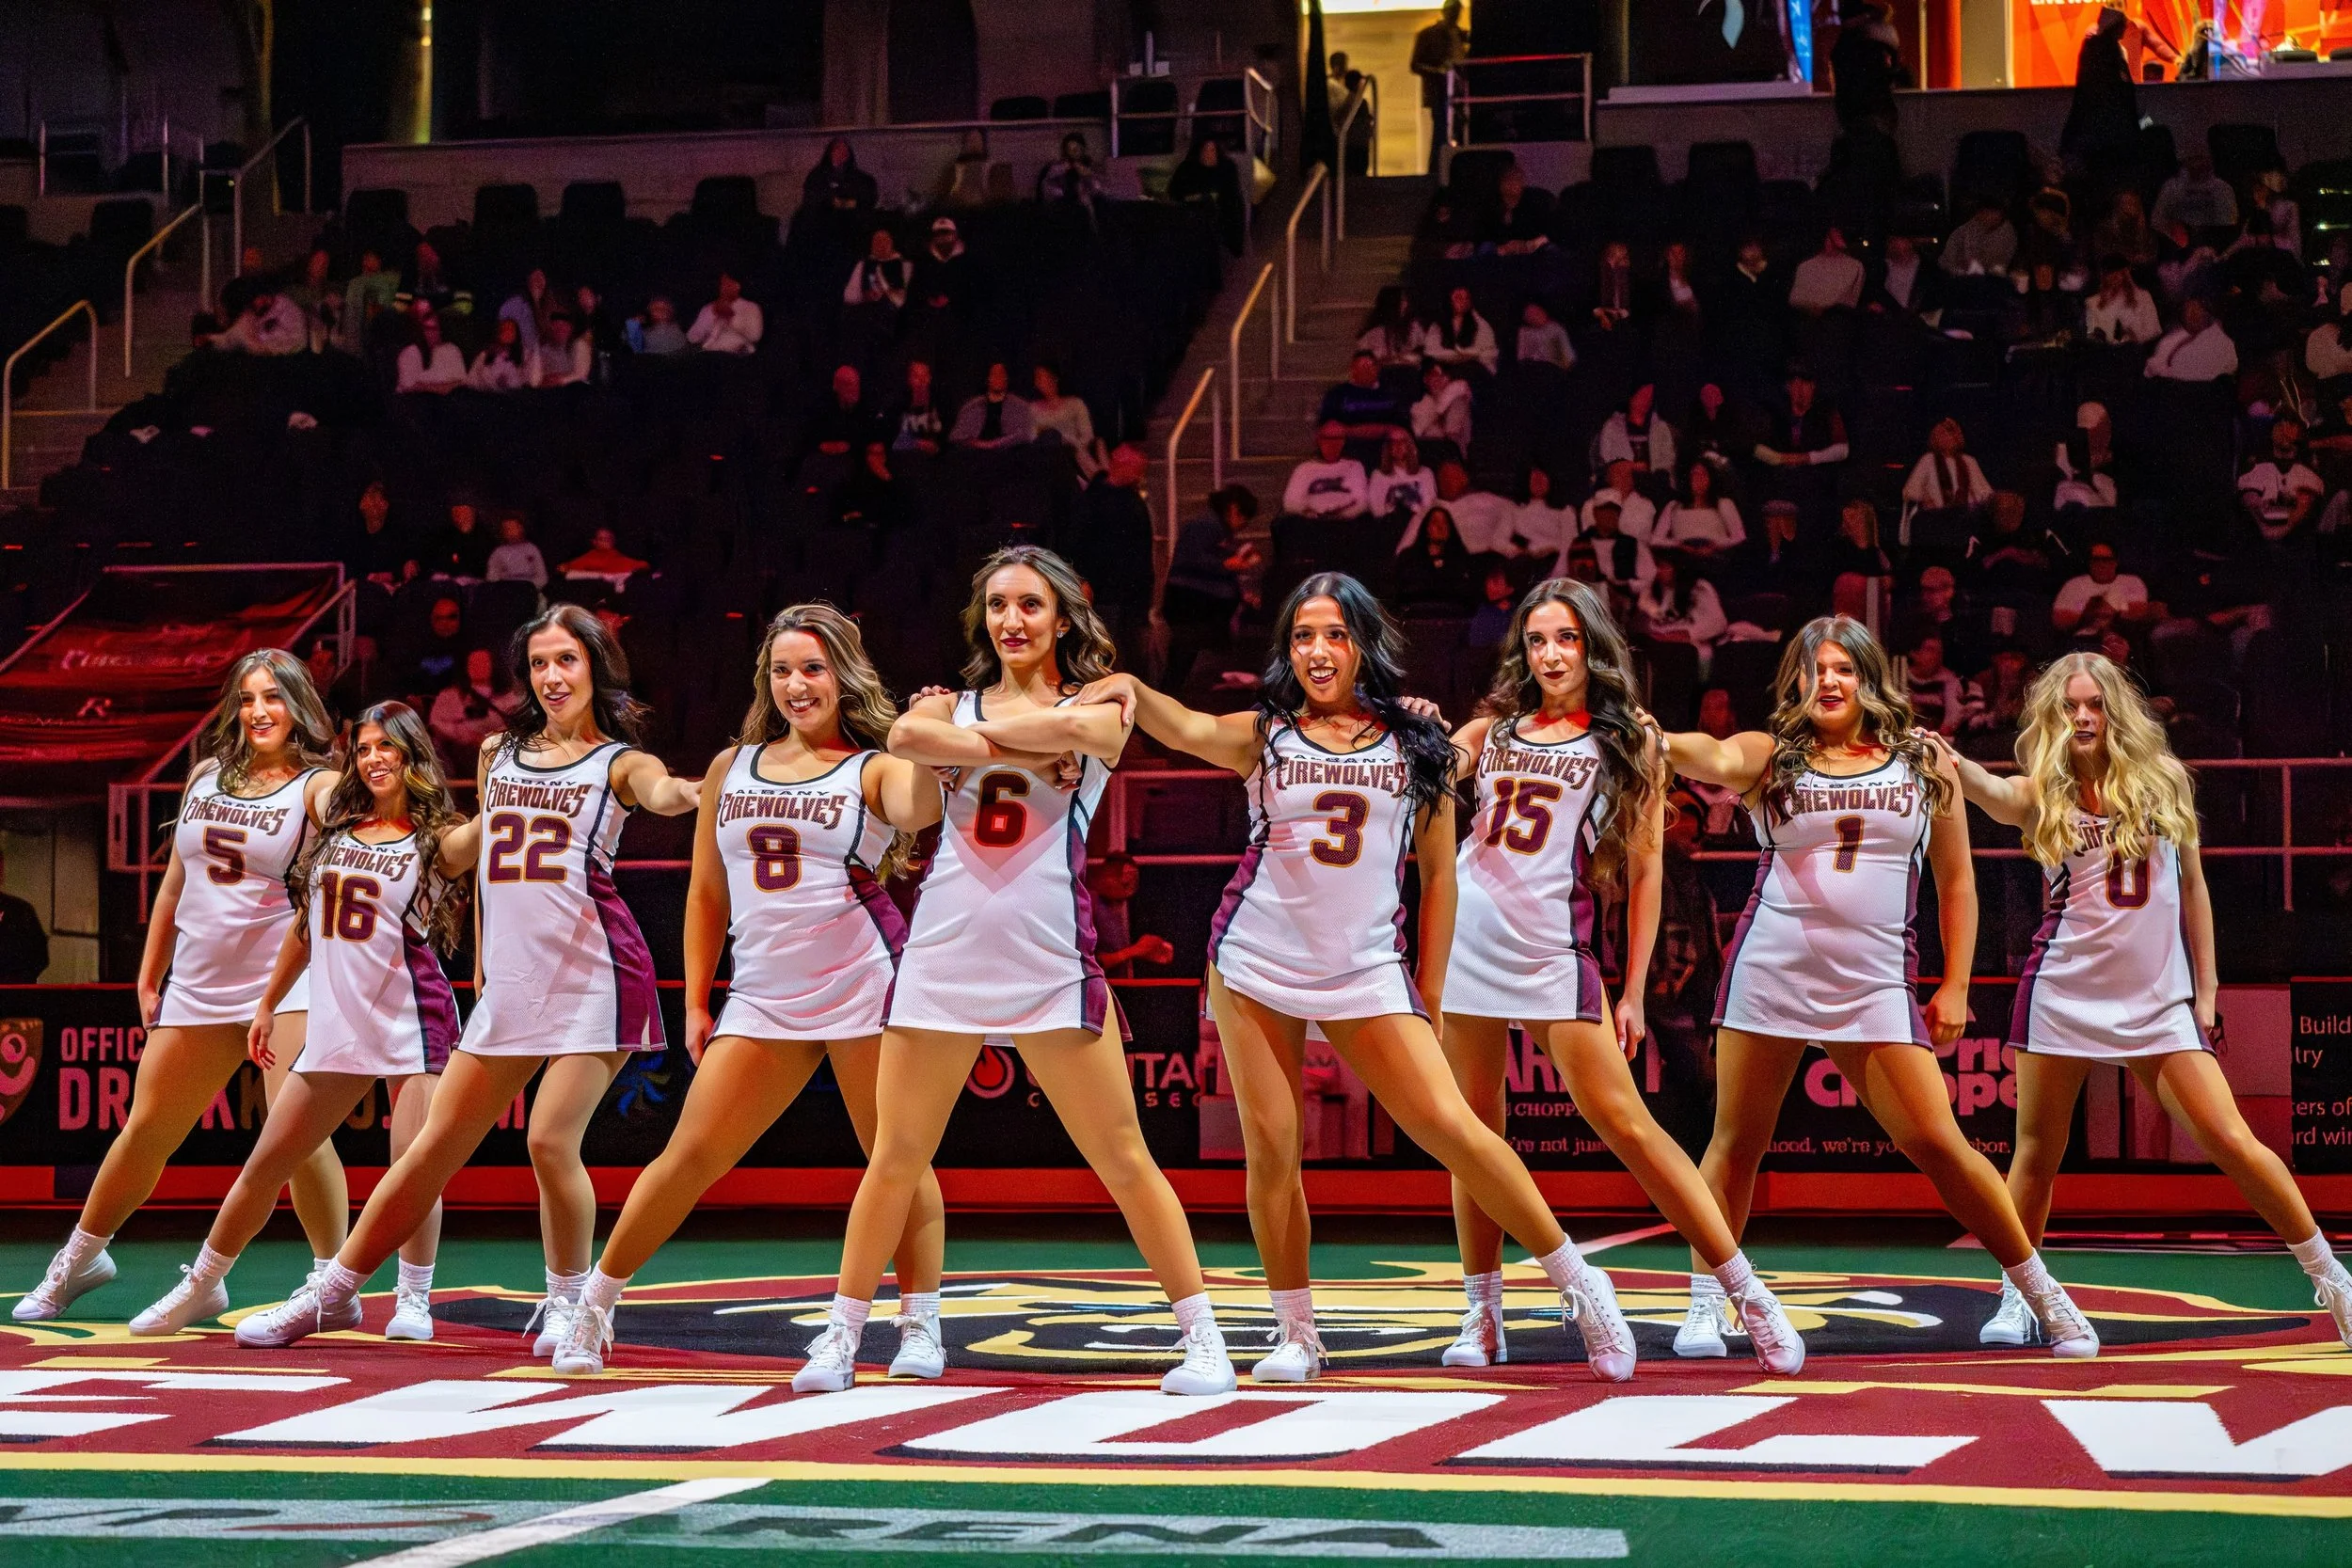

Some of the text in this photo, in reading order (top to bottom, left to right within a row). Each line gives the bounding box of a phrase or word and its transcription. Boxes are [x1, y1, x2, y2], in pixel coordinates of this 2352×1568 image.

[1275, 756, 1409, 799] FIREWOLVES
[1294, 753, 1391, 764] ALBANY
[1480, 747, 1598, 790] FIREWOLVES
[486, 777, 593, 818] FIREWOLVES
[500, 775, 577, 787] ALBANY
[736, 788, 830, 797] ALBANY
[1795, 780, 1889, 789] ALBANY
[183, 797, 292, 836] FIREWOLVES
[202, 796, 275, 810] ALBANY
[719, 793, 849, 831] FIREWOLVES
[974, 770, 1031, 848] 6
[1485, 776, 1564, 856] 15
[487, 811, 573, 884] 22
[1309, 790, 1371, 868] 3
[1833, 815, 1866, 874] 1
[203, 825, 248, 886] 5
[746, 823, 803, 894] 8
[320, 870, 382, 942] 16
[60, 1026, 145, 1063] OFFIC
[1515, 1102, 1581, 1117] CHOPP
[1540, 1137, 1569, 1153] not
[1822, 1136, 1869, 1154] we're
